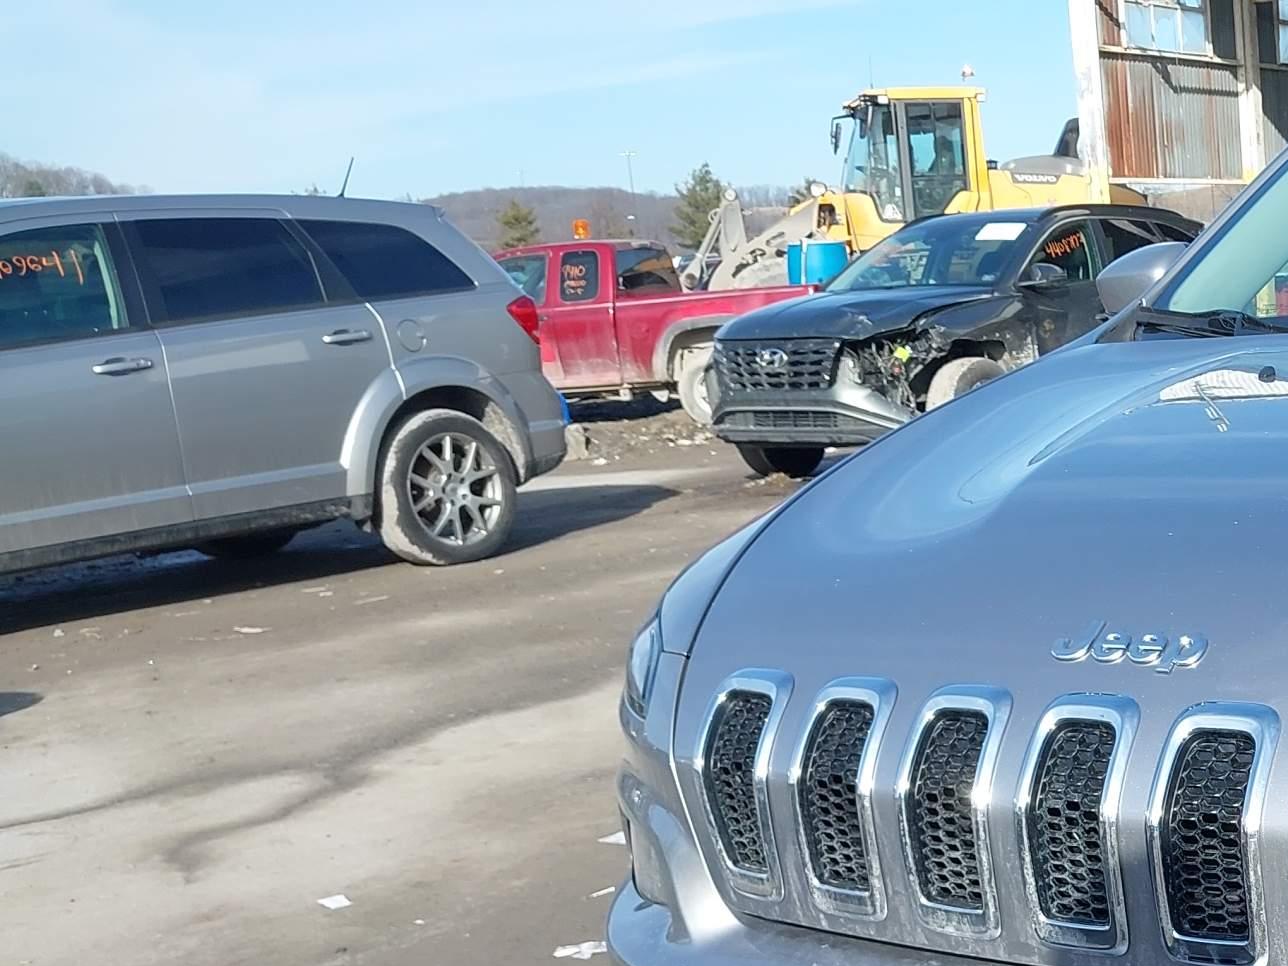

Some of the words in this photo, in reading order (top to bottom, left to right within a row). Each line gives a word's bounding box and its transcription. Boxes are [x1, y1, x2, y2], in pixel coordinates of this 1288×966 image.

[1013, 174, 1058, 183] VOLVO
[0, 248, 84, 286] 09641
[1050, 620, 1209, 676] Jeep
